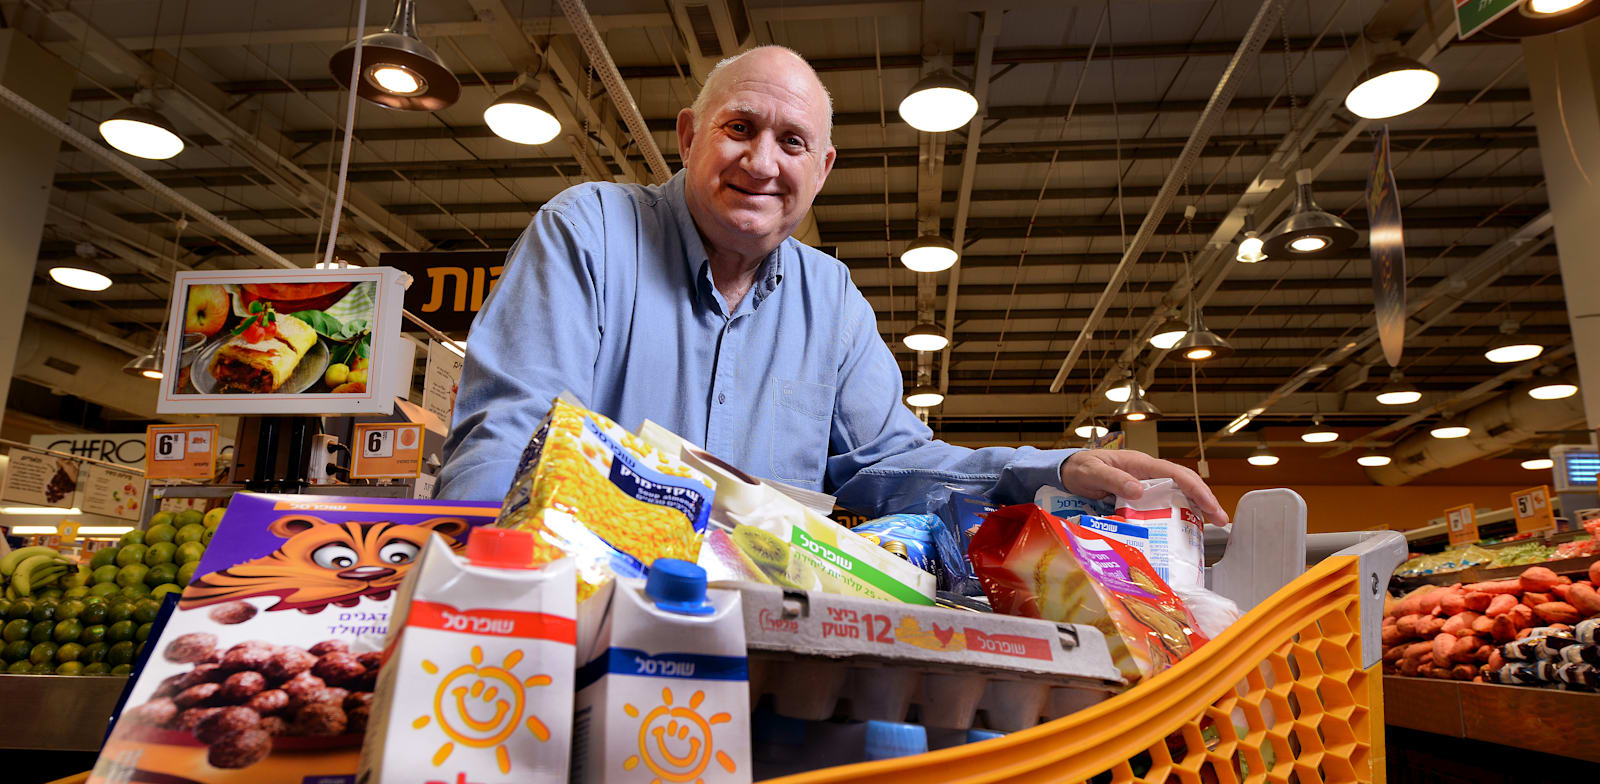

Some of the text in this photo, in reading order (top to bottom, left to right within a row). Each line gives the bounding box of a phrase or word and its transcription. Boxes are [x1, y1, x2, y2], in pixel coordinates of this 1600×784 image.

[46, 439, 147, 464] CHERO
[159, 434, 173, 455] 6
[367, 431, 382, 453] 6
[1057, 498, 1096, 512] פרסל
[1518, 498, 1527, 514] 5
[1090, 518, 1118, 533] שופרסל
[800, 534, 853, 570] שופרסל
[793, 551, 875, 598] 25 קלוריות ליחידה
[339, 612, 388, 621] דגנים
[441, 611, 515, 634] שופרסל
[827, 607, 859, 623] ביצי
[328, 624, 387, 637] שוקולד
[821, 621, 859, 639] משק
[861, 613, 895, 644] 12
[977, 636, 1026, 655] שופרסל
[635, 656, 696, 677] שופרסל
